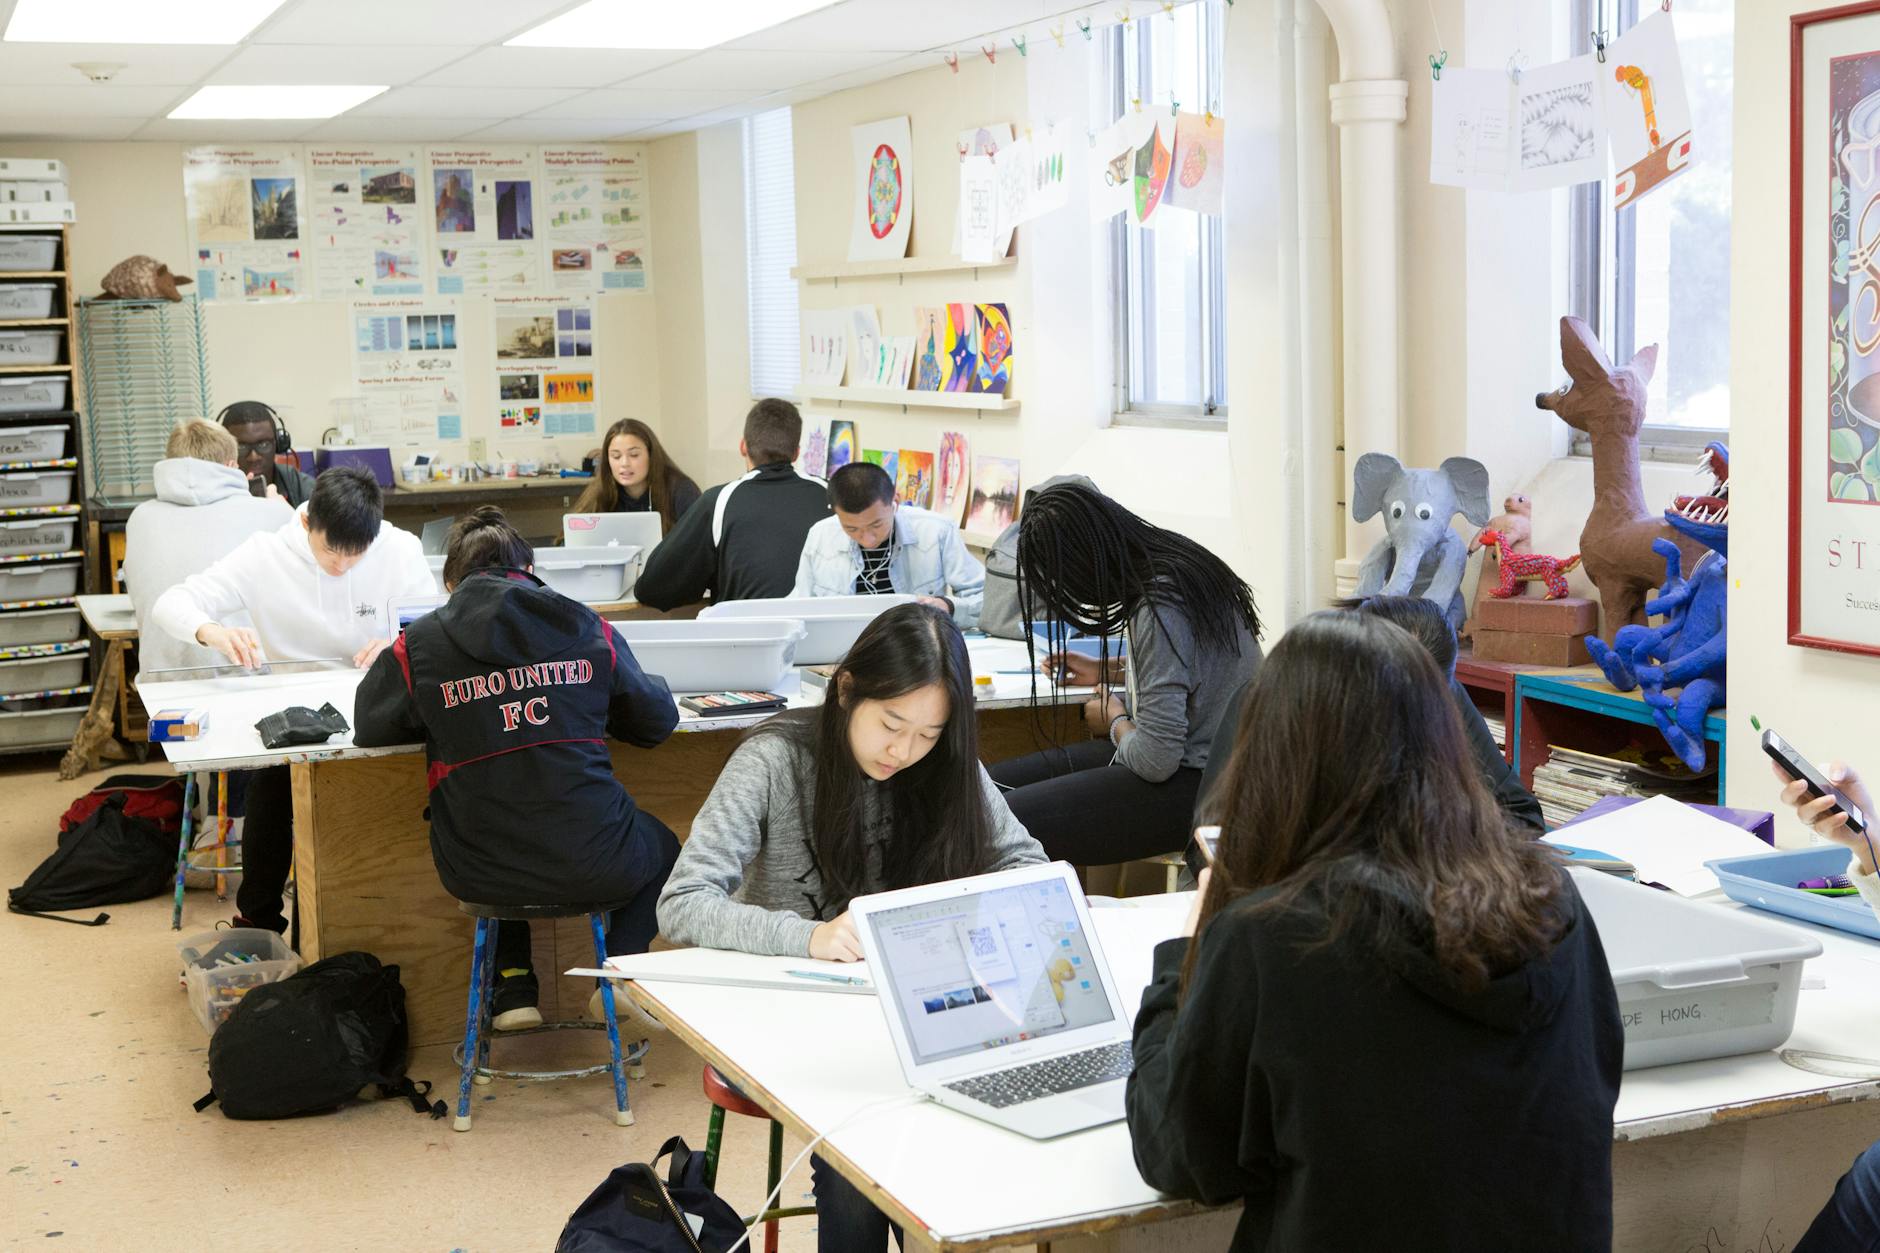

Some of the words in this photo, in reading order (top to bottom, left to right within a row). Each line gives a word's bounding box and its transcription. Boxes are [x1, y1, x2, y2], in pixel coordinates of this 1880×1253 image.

[233, 158, 280, 166] Perspective
[545, 158, 574, 166] Multiple
[576, 158, 610, 166] Vanishing
[1828, 539, 1880, 571] ST
[1846, 592, 1880, 611] Succes
[440, 671, 506, 709] EURO
[507, 659, 593, 691] UNITED
[499, 696, 550, 732] FC
[1623, 1012, 1643, 1028] DE
[1661, 1004, 1701, 1024] HONG
